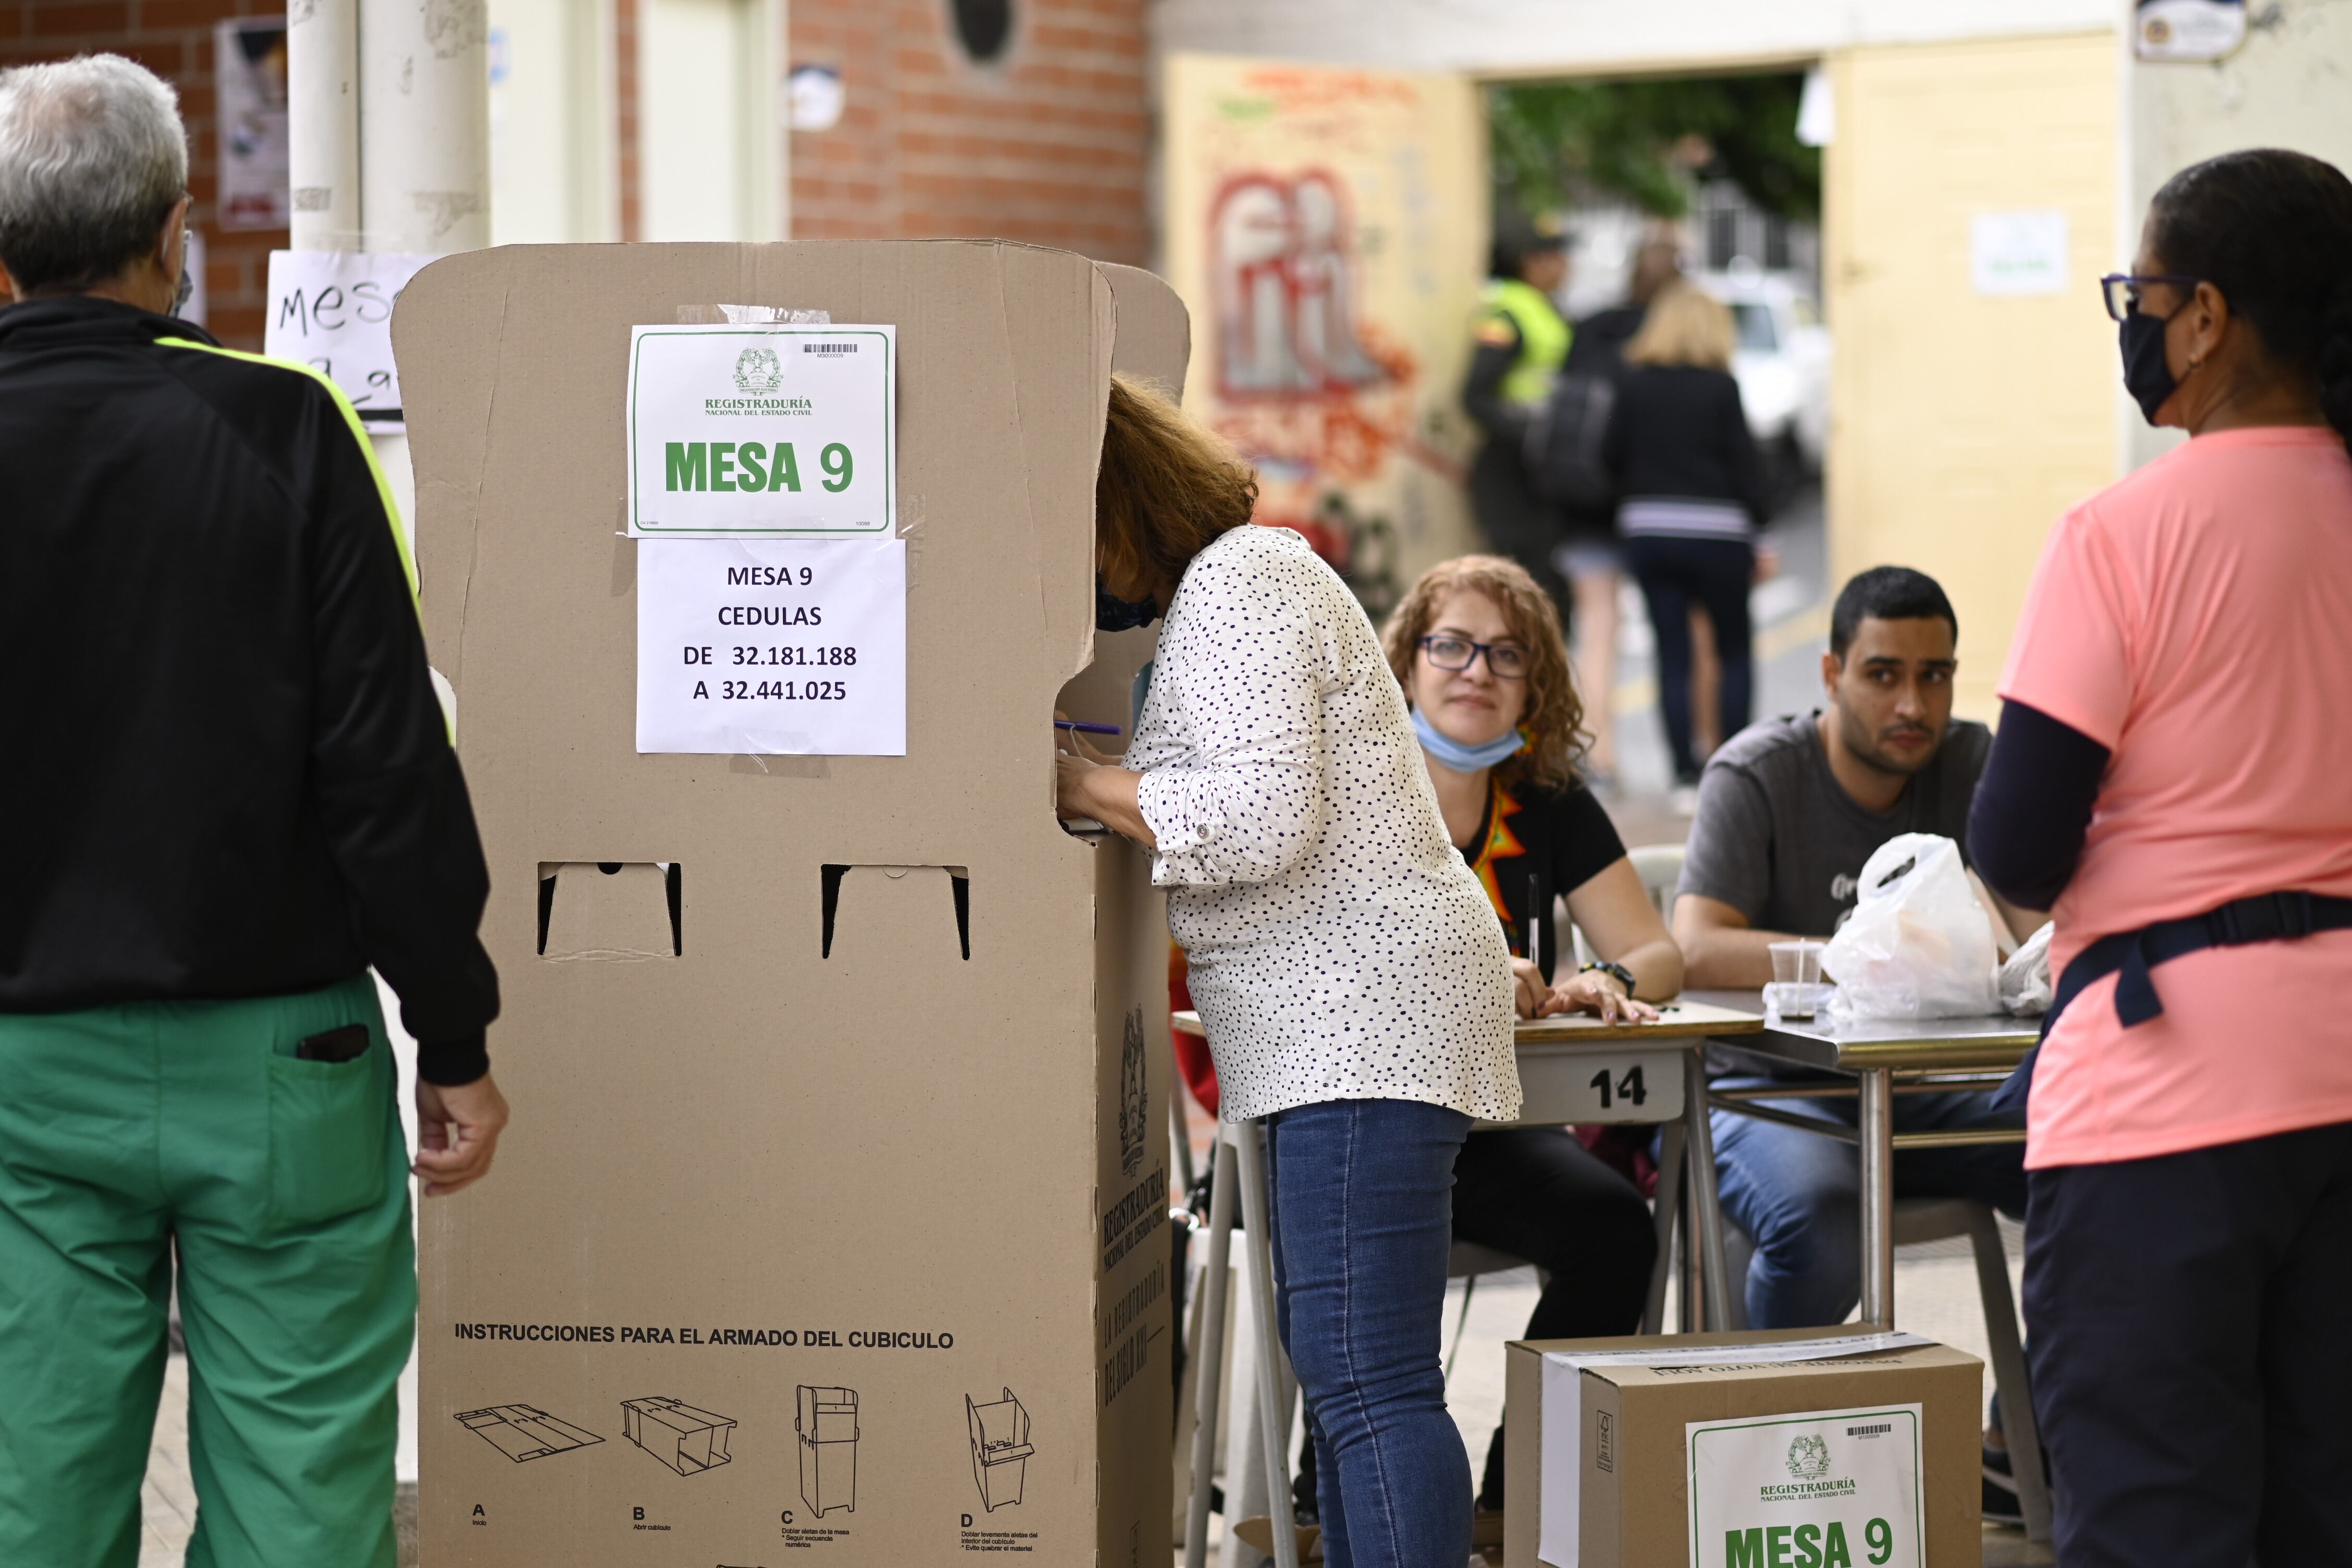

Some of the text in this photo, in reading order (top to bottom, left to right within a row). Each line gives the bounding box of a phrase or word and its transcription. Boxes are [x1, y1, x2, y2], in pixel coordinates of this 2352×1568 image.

[279, 281, 401, 337] Mes
[705, 396, 813, 409] REGISTRADURÍA
[665, 442, 853, 493] MESA 9
[728, 567, 812, 585] MESA 9
[718, 607, 822, 626] CEDULAS
[684, 647, 857, 666] DE 32.181.188
[693, 681, 846, 700] A 32.441.025
[1590, 1065, 1647, 1109] 14
[1104, 1158, 1165, 1248] REGISTRADURÍA
[456, 1323, 954, 1349] INSTRUCCIONES PARA EL ARMADO DEL CUBICULO
[1105, 1313, 1111, 1349] LA
[1105, 1355, 1116, 1407] DEL
[1117, 1336, 1134, 1393] SIGLO
[1709, 1364, 1766, 1373] VOTO
[1760, 1477, 1856, 1494] REGISTRADURÍA
[472, 1504, 485, 1516] A
[633, 1506, 645, 1521] B
[781, 1511, 793, 1524] C
[961, 1514, 973, 1527] D
[1725, 1517, 1892, 1568] MESA 9
